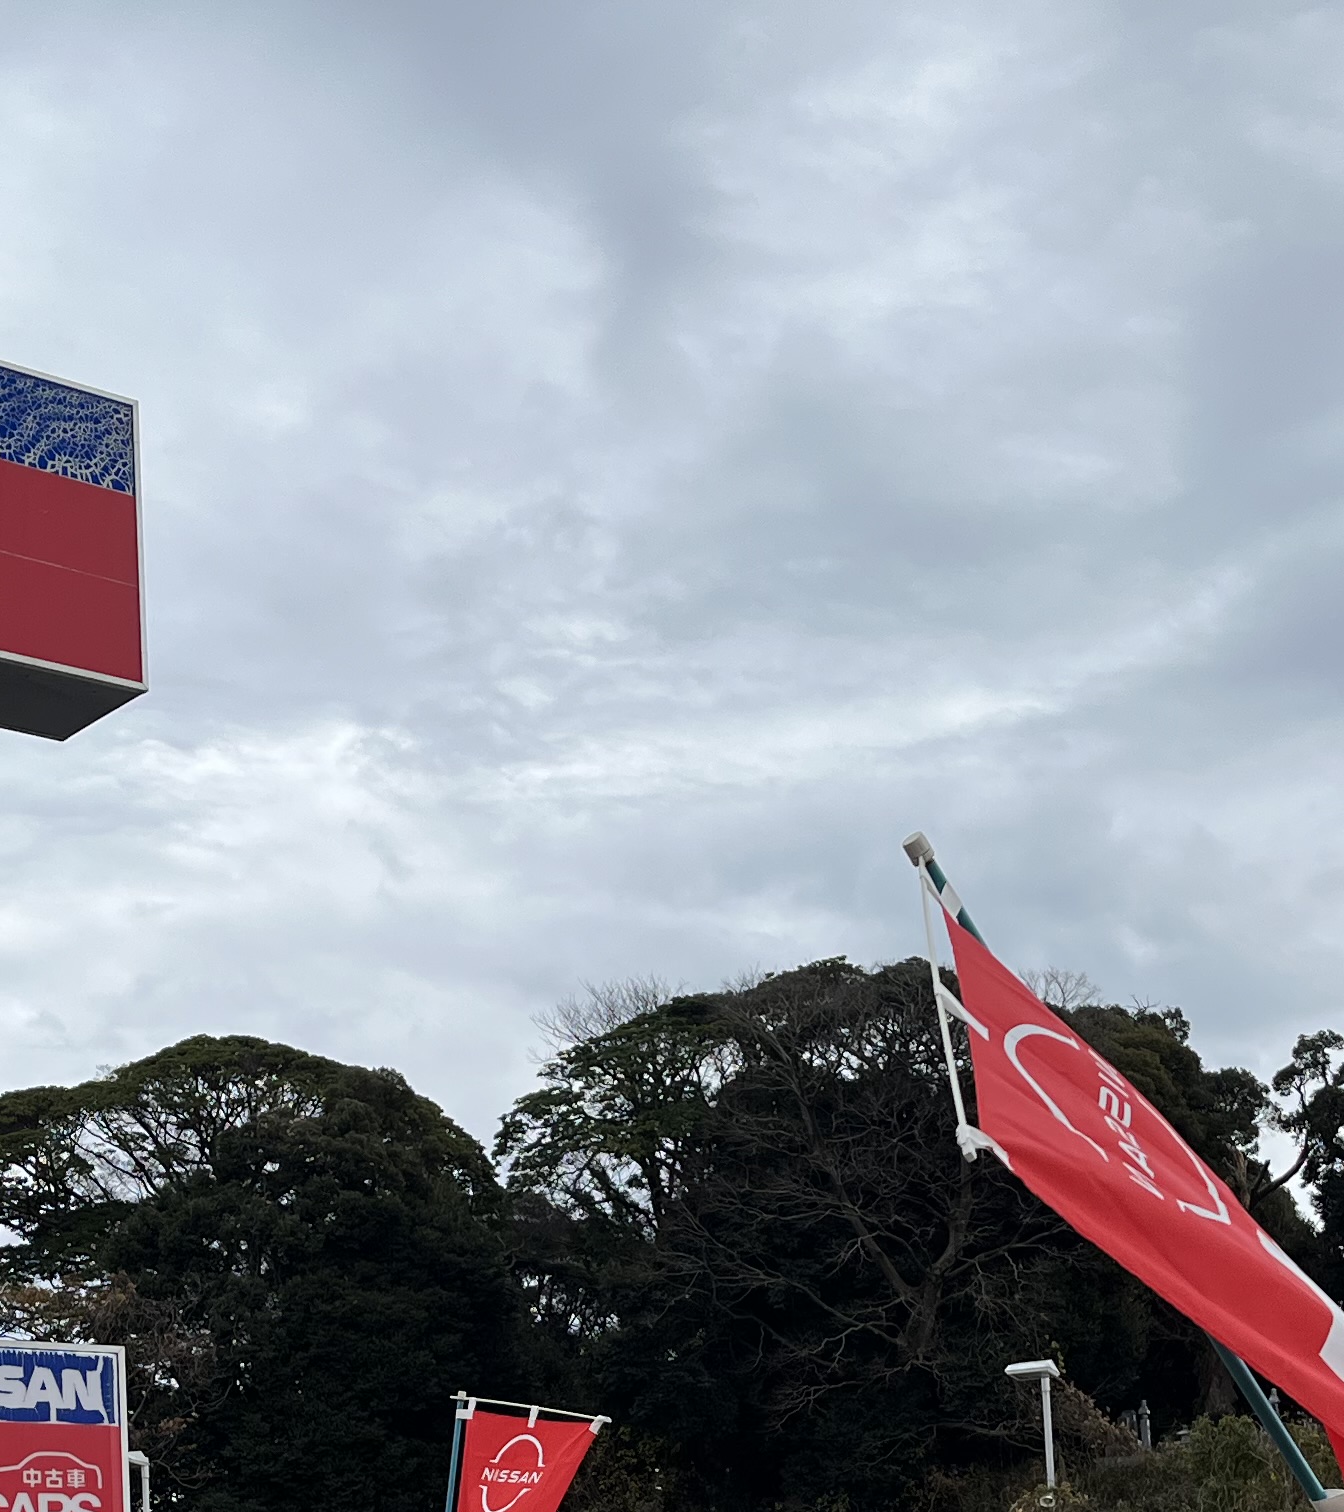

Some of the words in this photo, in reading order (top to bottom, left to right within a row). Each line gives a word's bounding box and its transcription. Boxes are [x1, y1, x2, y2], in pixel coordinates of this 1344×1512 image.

[22, 1467, 87, 1489] 中古車
[480, 1464, 544, 1486] NISSAN
